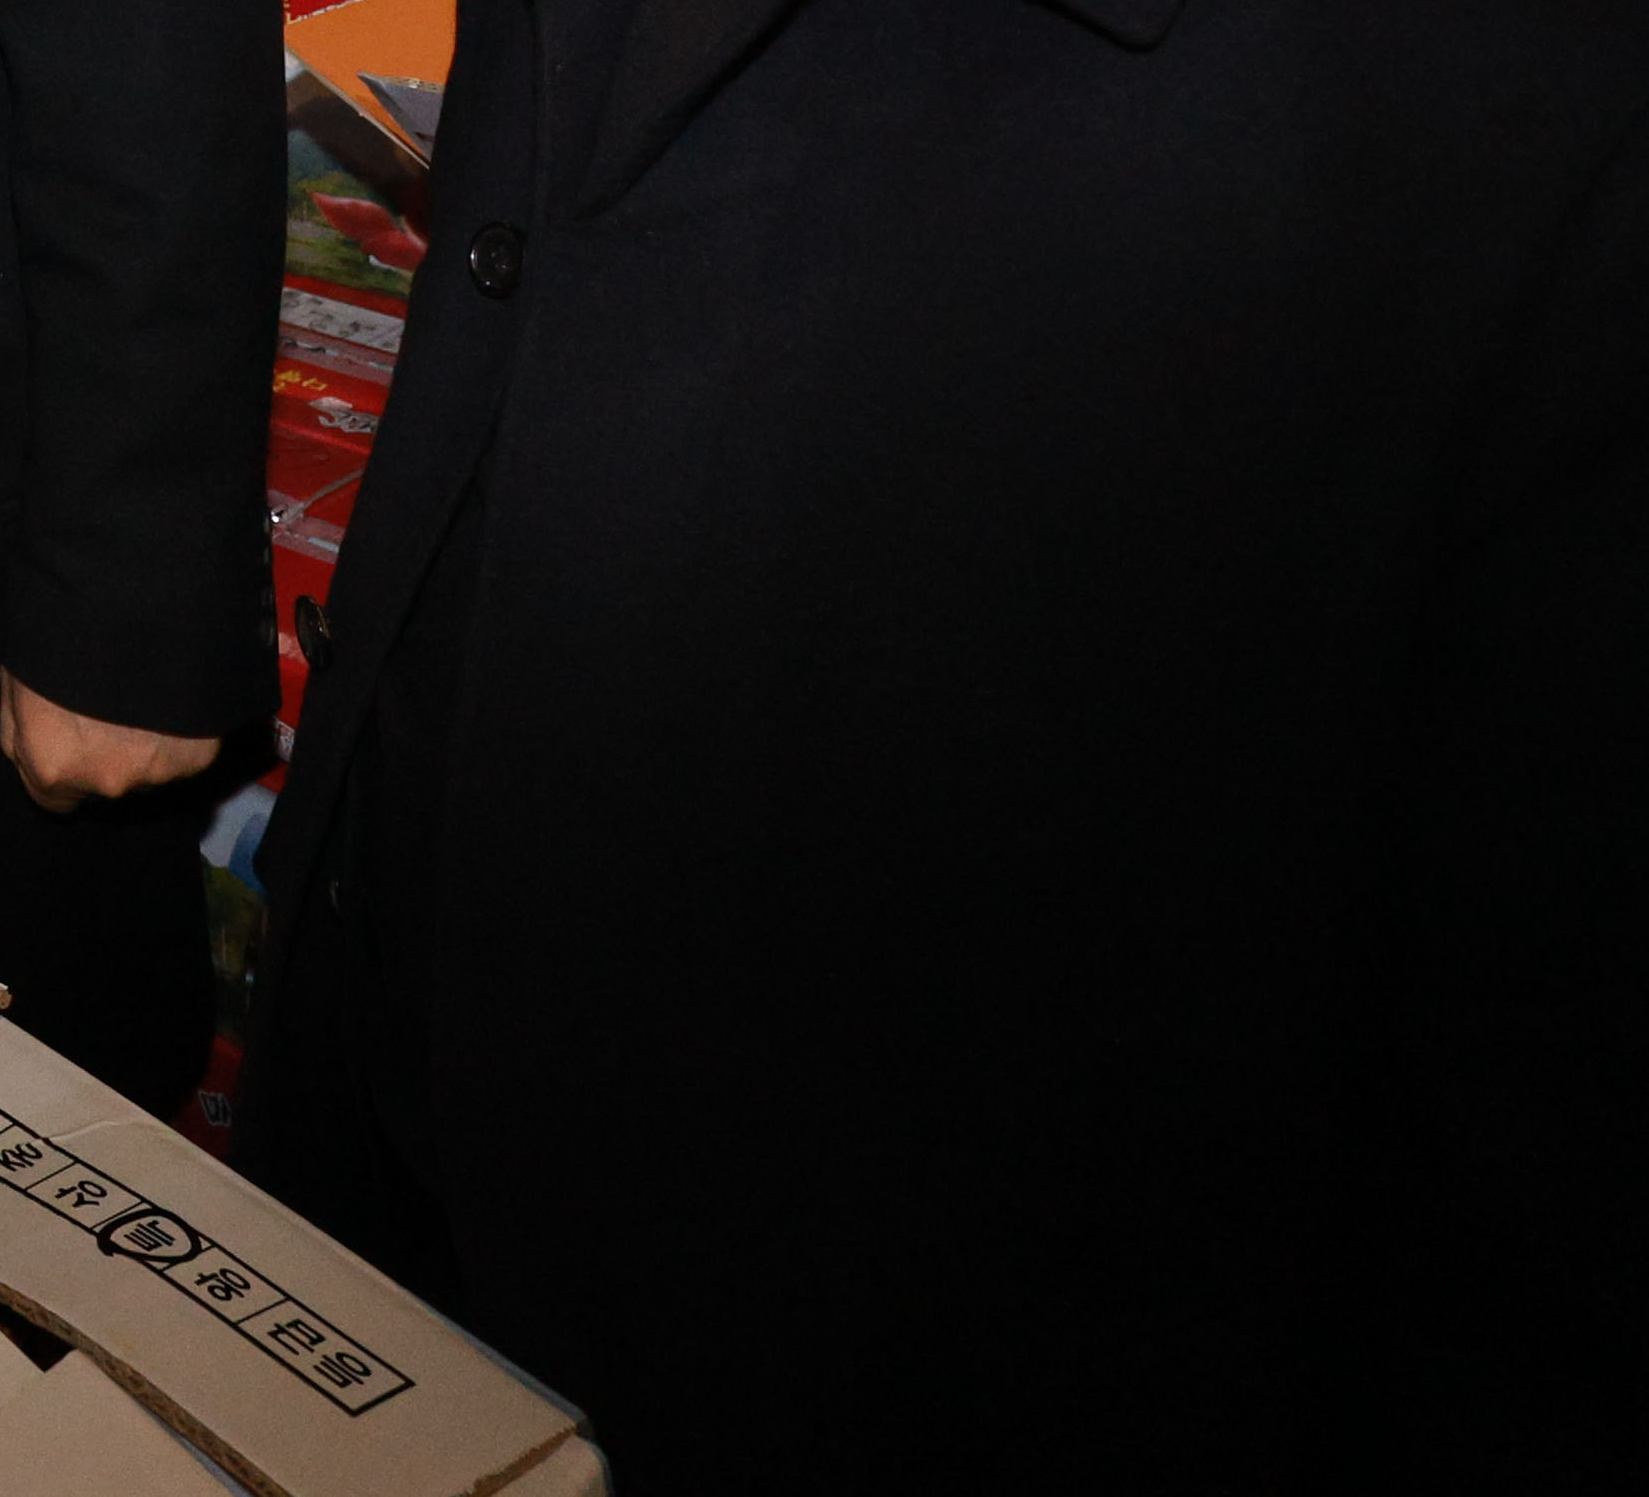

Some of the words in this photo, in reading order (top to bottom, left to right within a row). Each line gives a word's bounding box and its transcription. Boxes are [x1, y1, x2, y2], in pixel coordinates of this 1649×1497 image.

[54, 1180, 108, 1208] 상
[123, 1219, 176, 1253] 특
[193, 1268, 251, 1303] 왕
[267, 1318, 372, 1389] 등급
